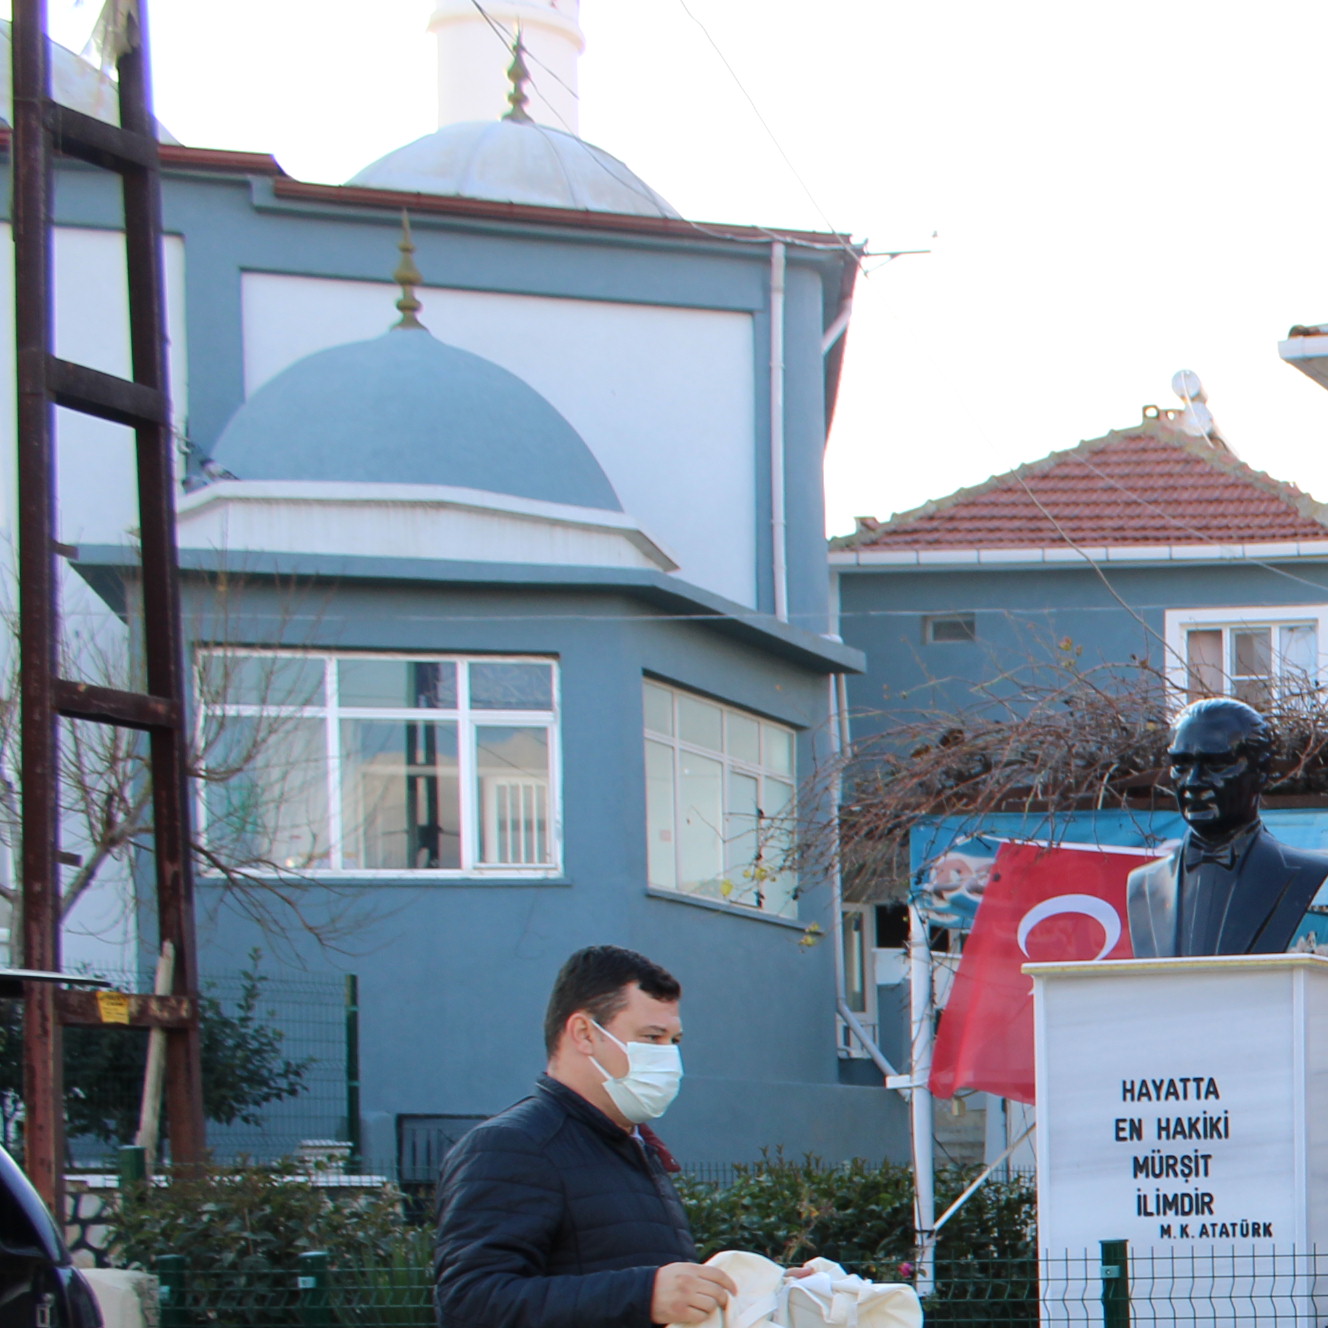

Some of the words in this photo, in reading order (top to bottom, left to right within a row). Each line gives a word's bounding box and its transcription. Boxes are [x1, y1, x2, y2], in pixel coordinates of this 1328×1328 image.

[1121, 1076, 1221, 1102] HAYATTA
[1114, 1118, 1143, 1142] EN
[1156, 1109, 1230, 1141] HAKİKİ
[1132, 1148, 1213, 1184] MÜRŞİT
[1136, 1187, 1215, 1218] İLİMDİR
[1160, 1224, 1177, 1239] M.
[1179, 1223, 1195, 1239] K.
[1199, 1218, 1274, 1239] ATATÜRK
